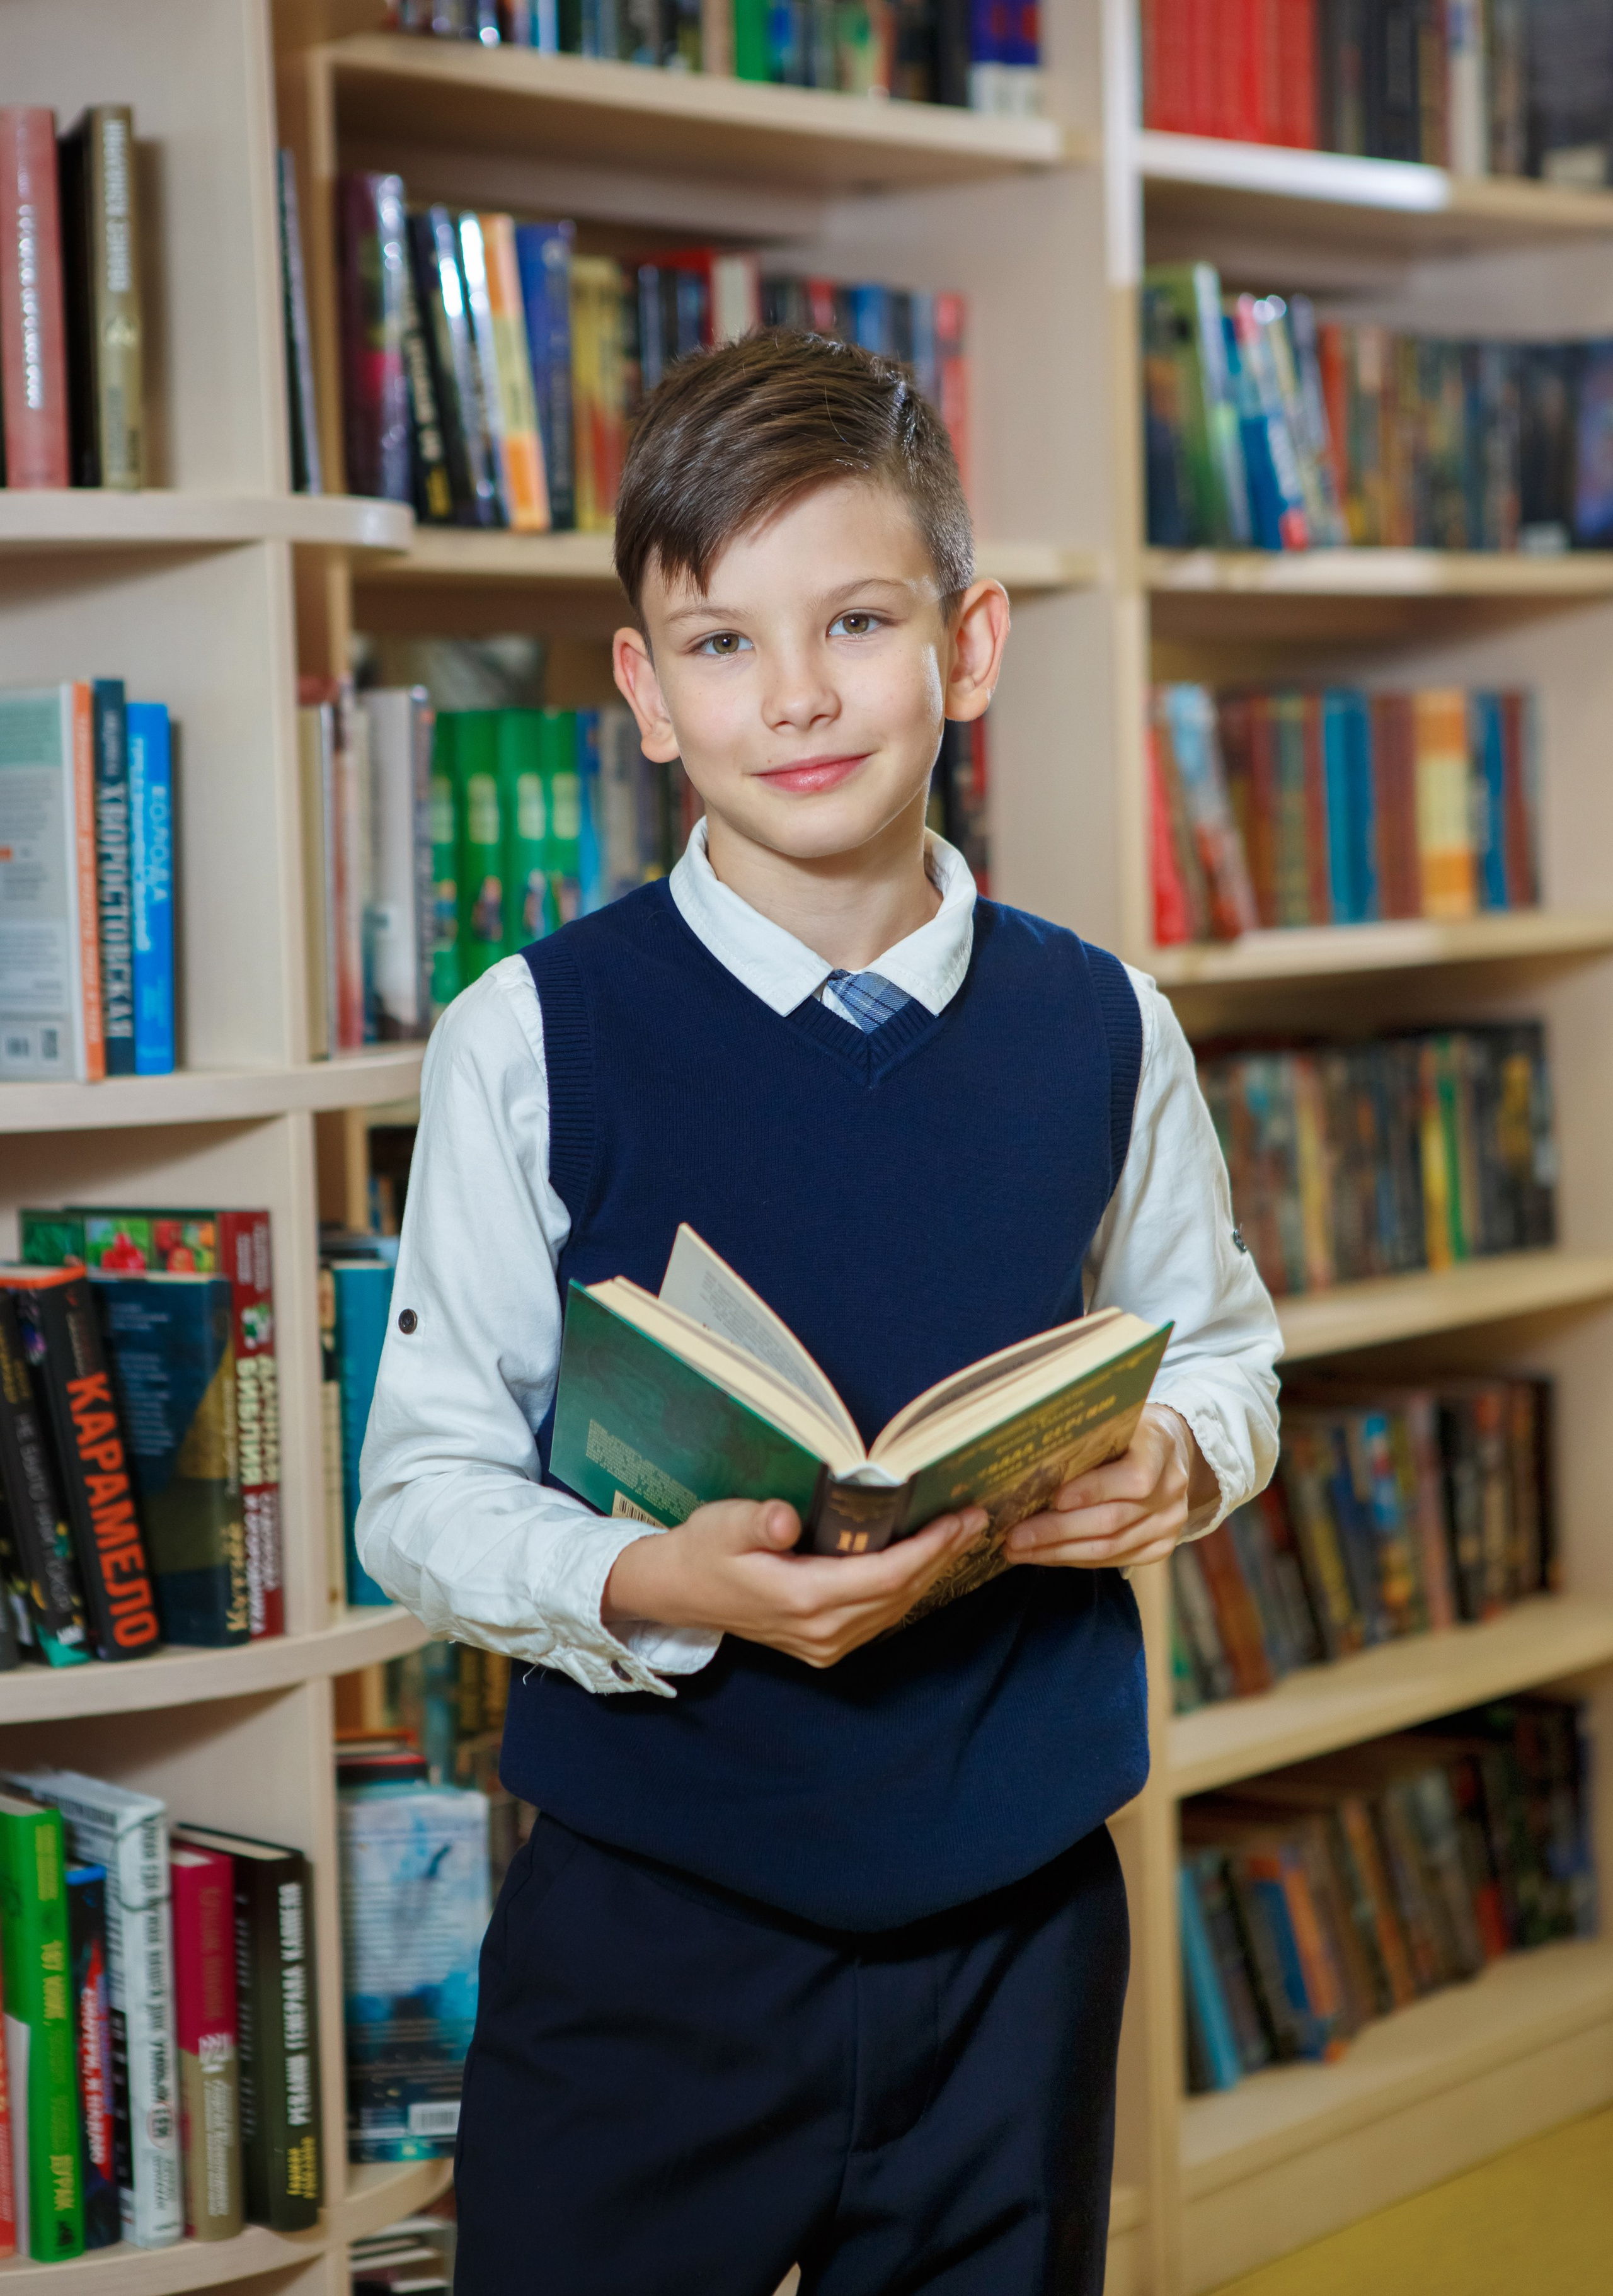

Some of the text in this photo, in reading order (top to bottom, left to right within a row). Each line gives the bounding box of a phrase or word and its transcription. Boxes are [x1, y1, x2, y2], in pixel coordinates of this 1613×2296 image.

[96, 780, 133, 1038] ХВОРОСТОВСКАЯ
[66, 1372, 159, 1648] КАРАМЕЛО
[236, 1357, 261, 1486] БИБЛИЯ
